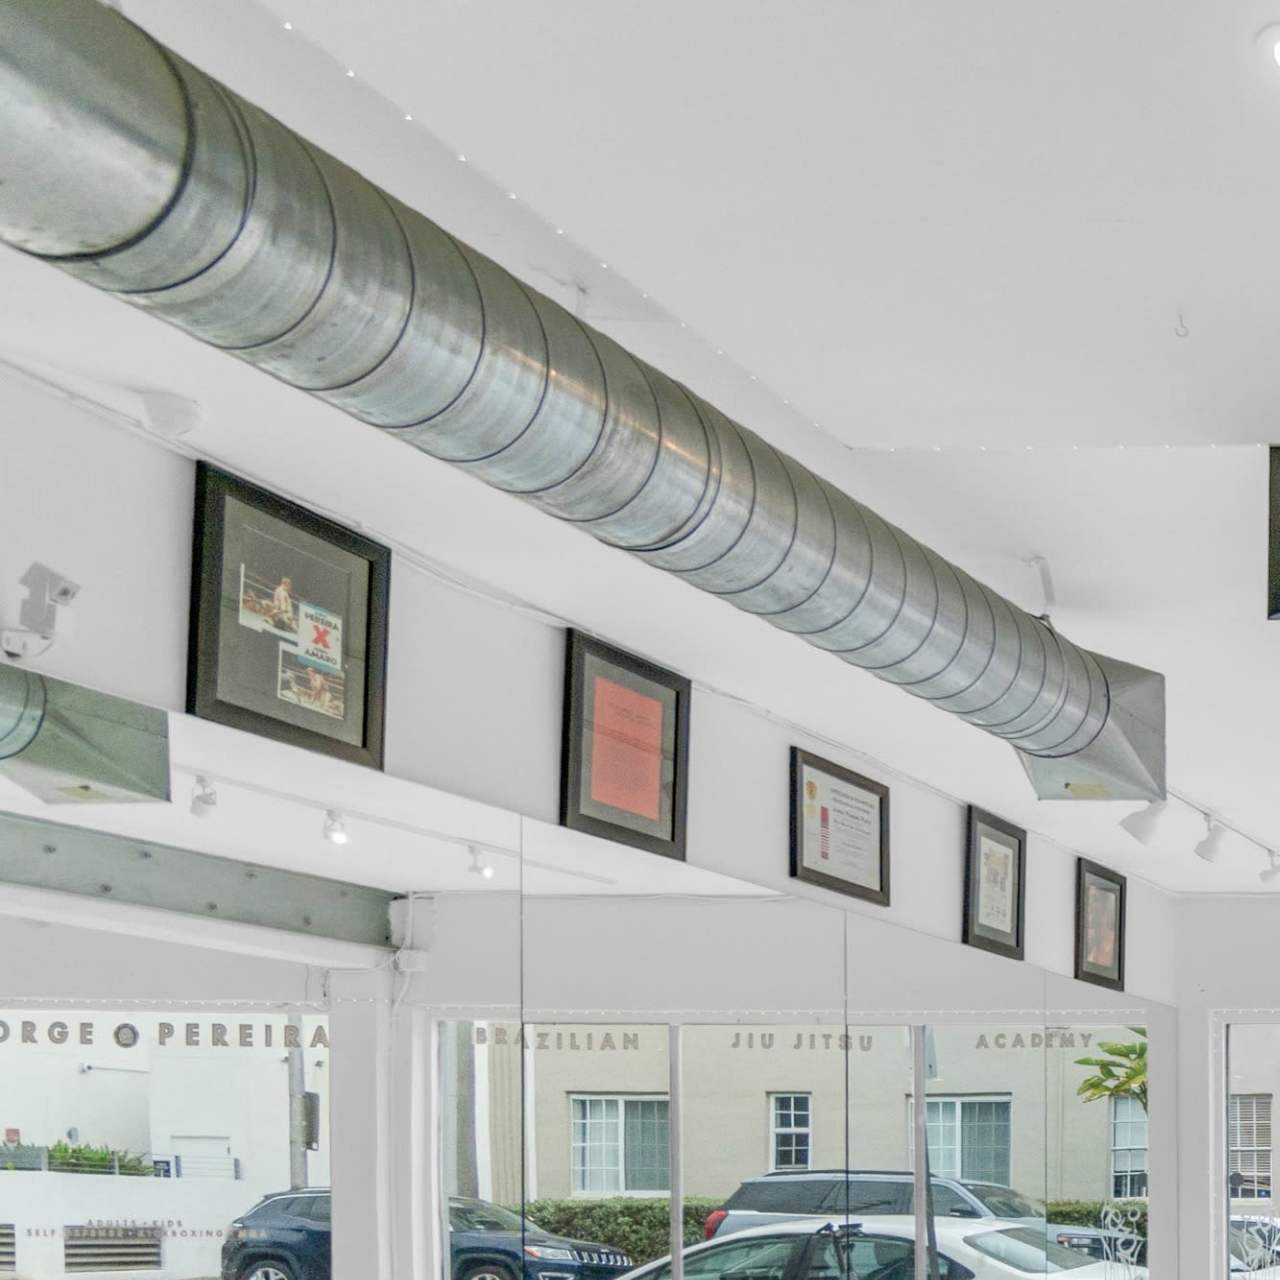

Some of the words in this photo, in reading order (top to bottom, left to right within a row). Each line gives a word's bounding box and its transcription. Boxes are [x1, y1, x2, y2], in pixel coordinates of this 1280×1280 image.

[312, 622, 331, 649] X
[158, 1022, 330, 1049] PEREIRA
[475, 1027, 640, 1051] BRAZILIAN
[731, 1032, 775, 1050] JIU
[792, 1033, 873, 1052] JITSU
[975, 1033, 1093, 1049] ACADEMY
[26, 1228, 57, 1238] SELF
[152, 1218, 184, 1228] KIDS
